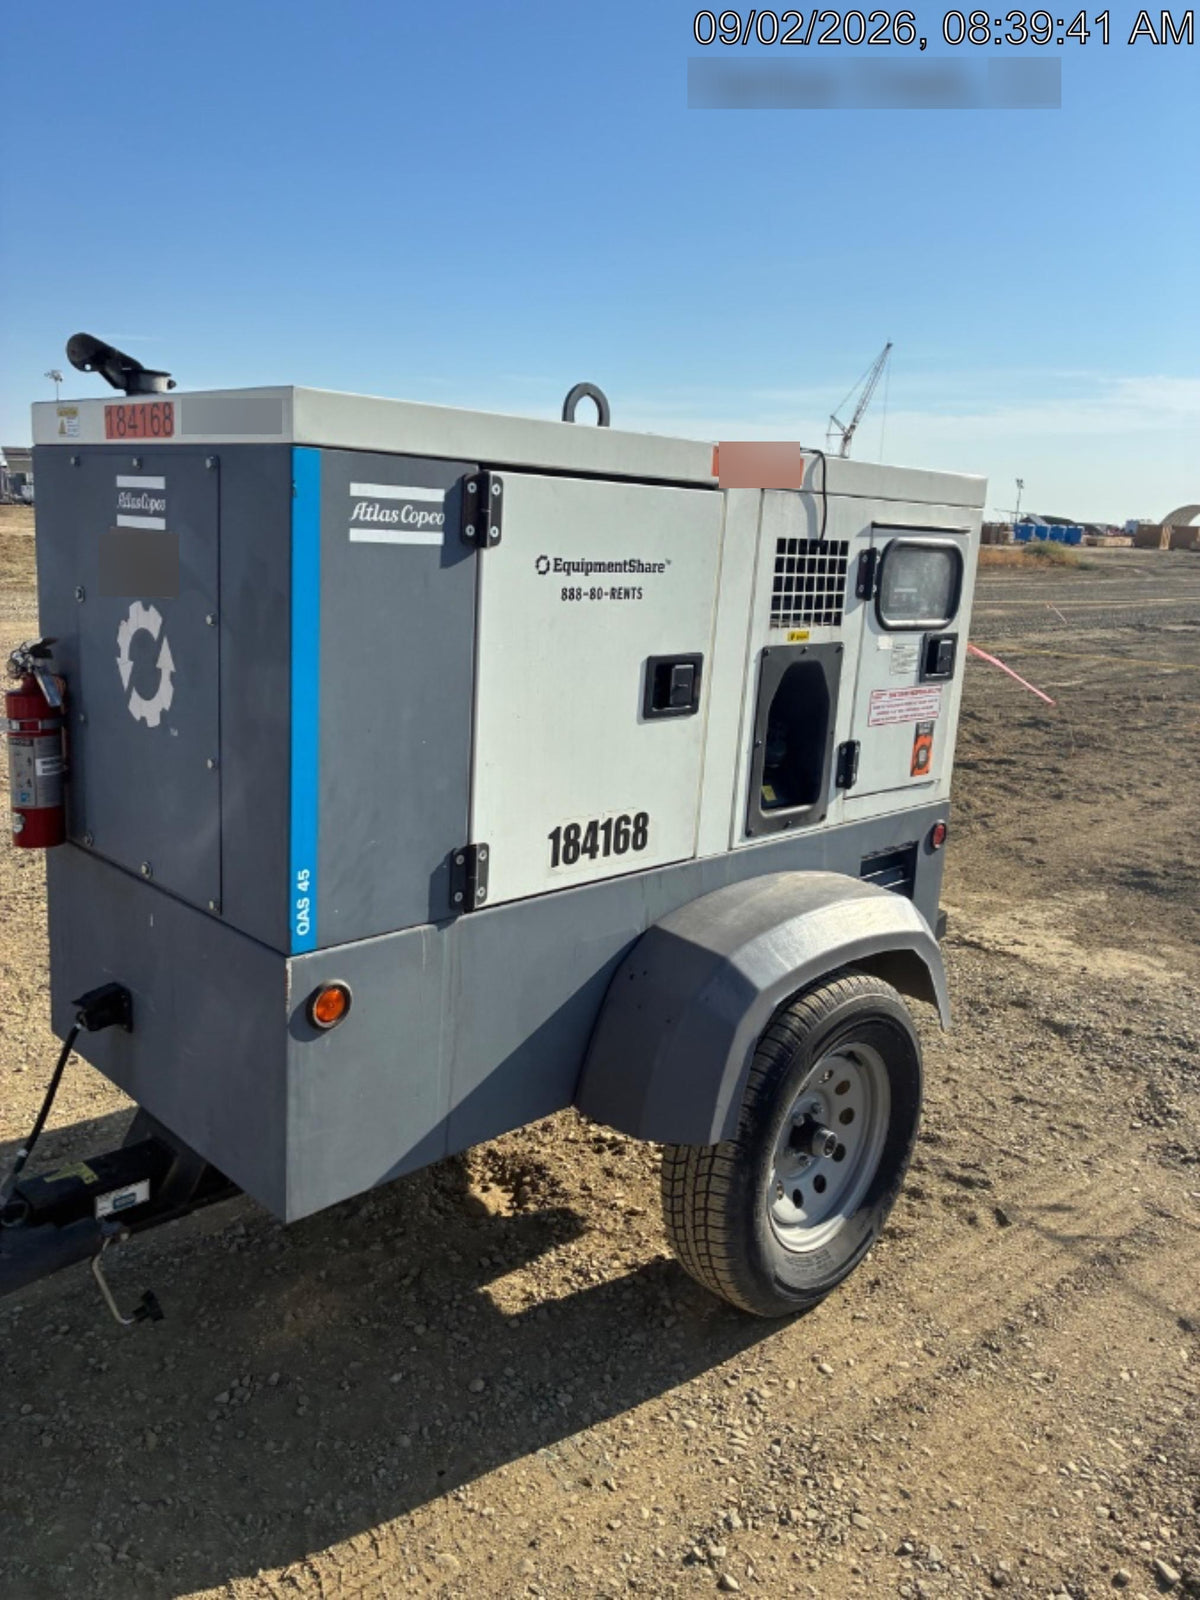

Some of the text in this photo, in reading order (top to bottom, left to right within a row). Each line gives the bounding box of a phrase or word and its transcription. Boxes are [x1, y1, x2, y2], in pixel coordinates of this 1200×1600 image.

[106, 403, 174, 439] 184168
[561, 586, 643, 602] 888-80-RENTS
[547, 811, 650, 868] 184168
[296, 868, 311, 936] QAS 45
